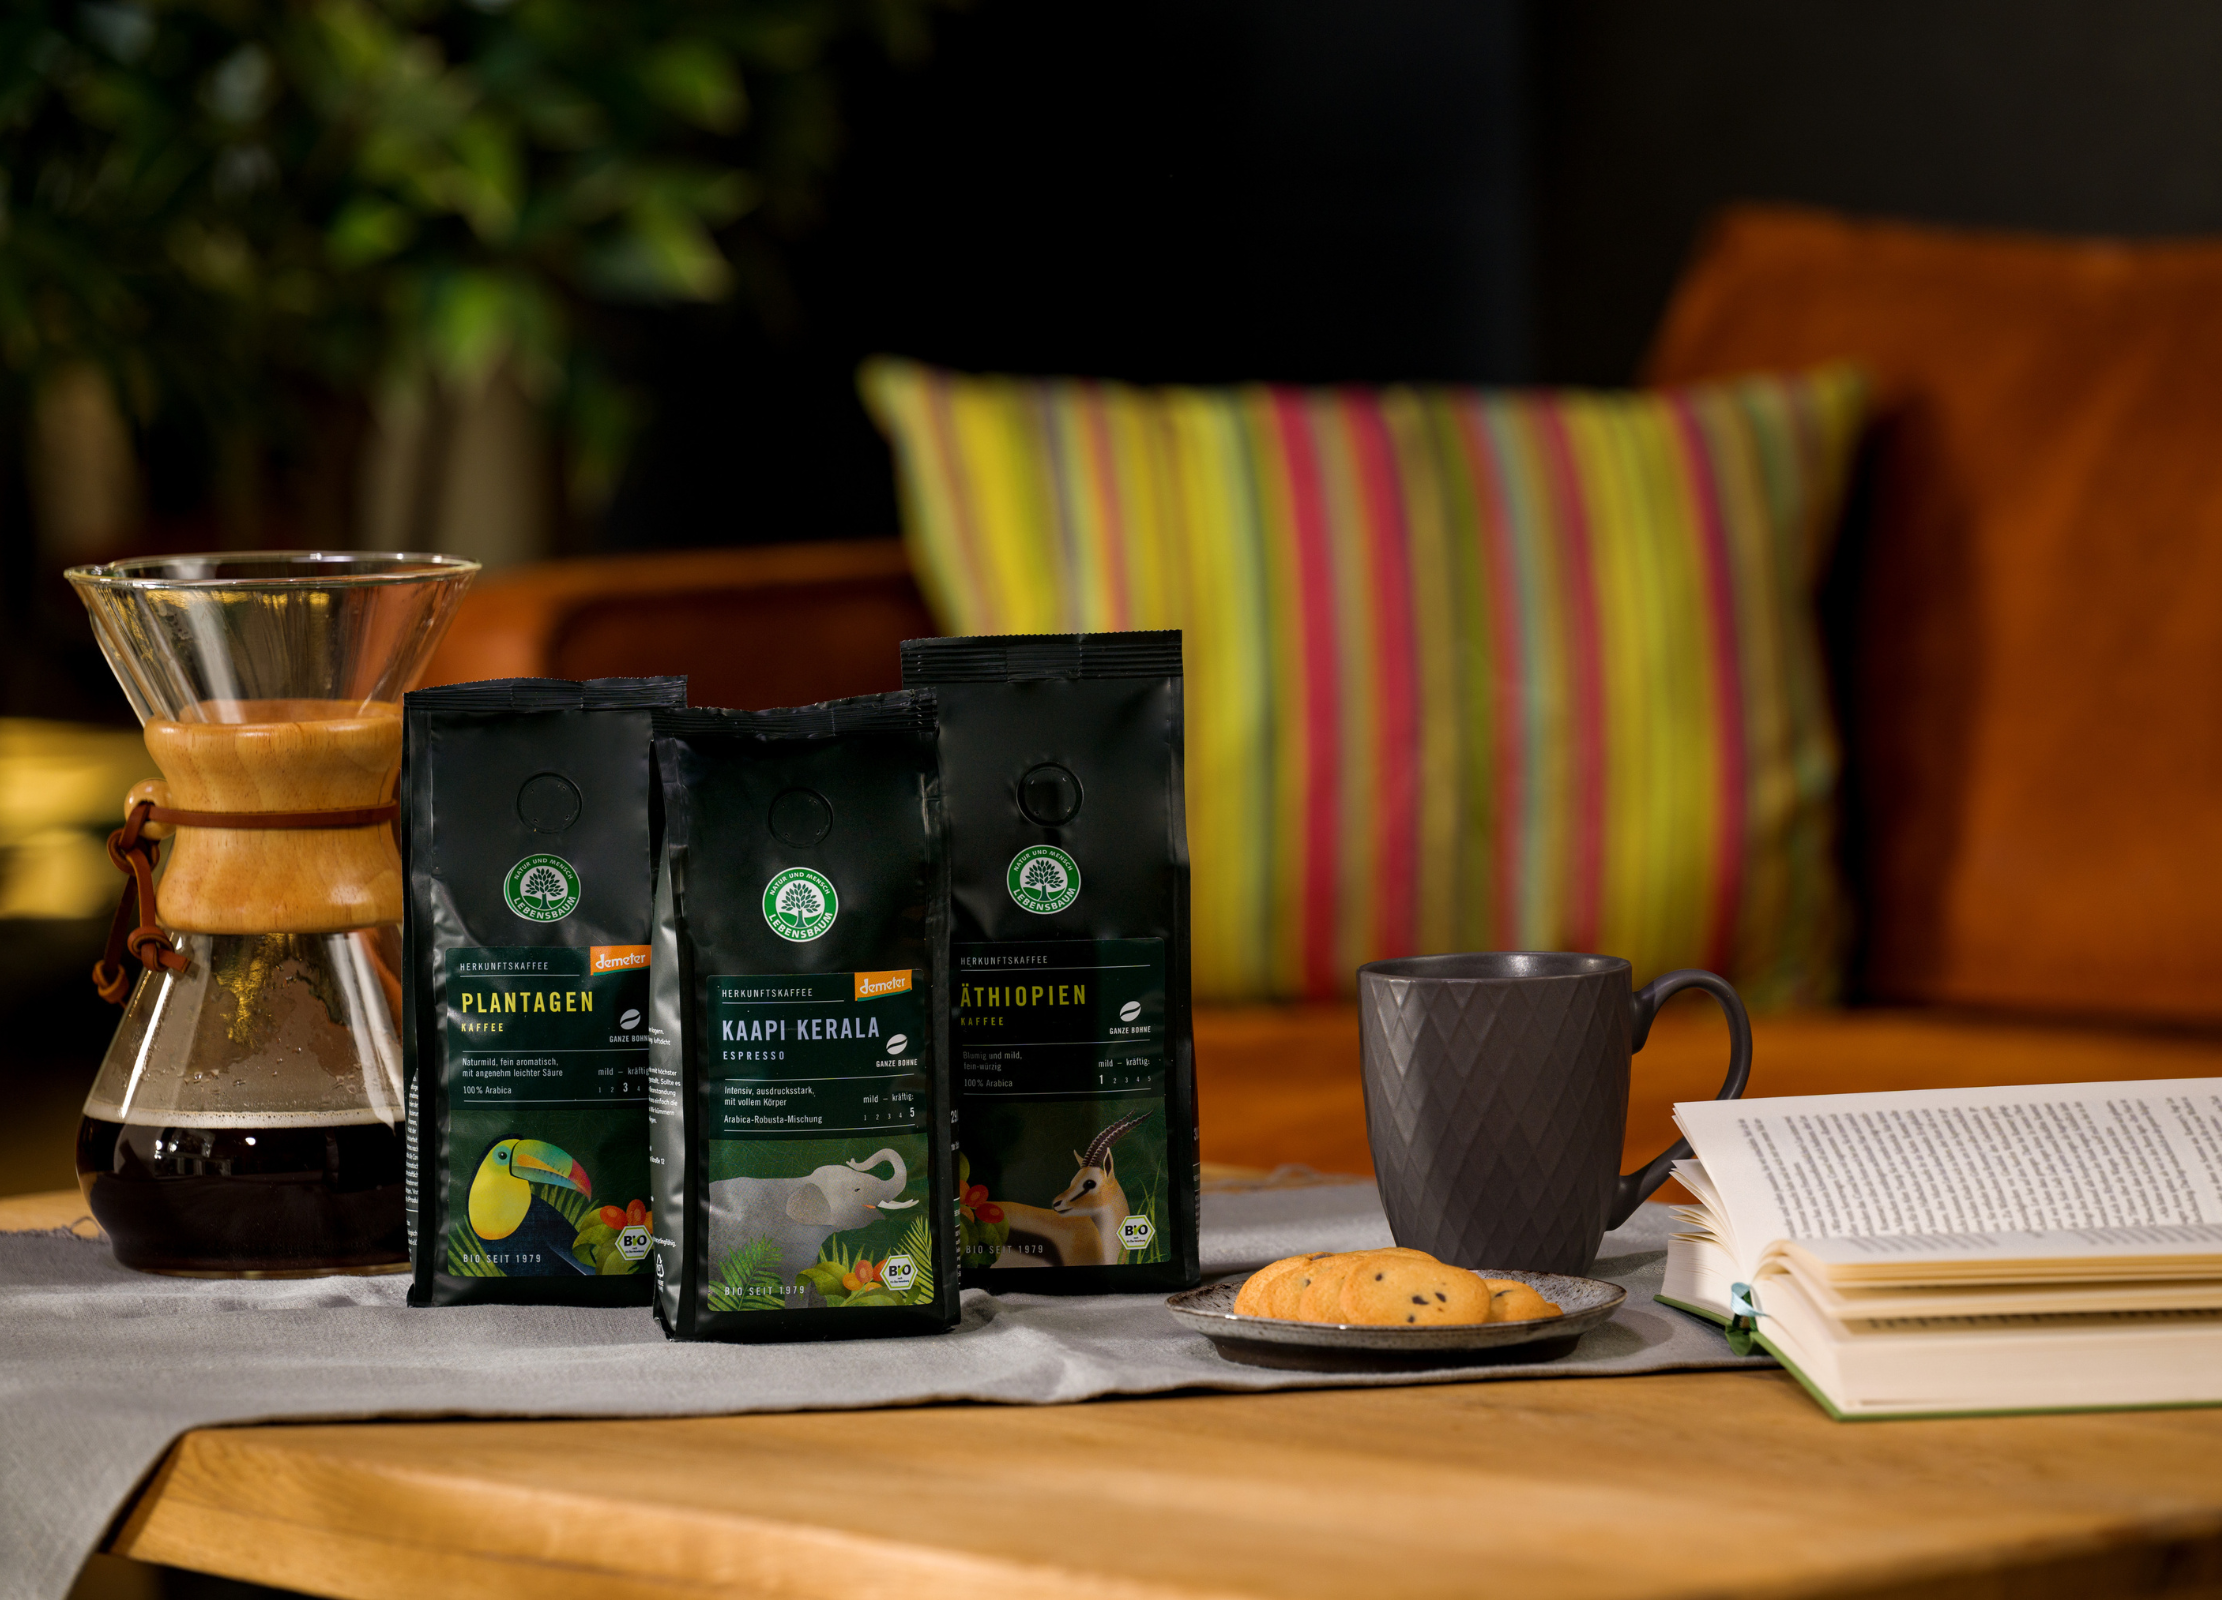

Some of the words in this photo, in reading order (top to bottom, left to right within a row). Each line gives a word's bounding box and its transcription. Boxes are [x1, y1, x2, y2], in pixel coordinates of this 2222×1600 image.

[1014, 853, 1031, 872] NATUR
[1049, 851, 1073, 871] MENSCH
[514, 862, 531, 880] NATUR
[550, 860, 574, 880] MENSCH
[770, 876, 787, 896] NATUR
[806, 874, 830, 895] MENSCH
[1013, 888, 1076, 911] LEBENSBAUM
[514, 896, 576, 919] LEBENSBAUM
[769, 912, 833, 938] LEBENSBAUM
[596, 954, 646, 969] demeter
[960, 956, 1048, 966] HERKUNFTSKAFFEE
[460, 962, 548, 971] HERKUNFTSKAFFEE
[860, 977, 905, 994] demeter
[722, 989, 813, 998] HERKUNFTSKAFFEE
[961, 983, 1086, 1007] ÄTHIOPIEN
[462, 992, 593, 1013] PLANTAGEN
[961, 1017, 1004, 1026] KAFFEE
[461, 1023, 504, 1032] KAFFEE
[723, 1020, 785, 1041] KAAPI
[797, 1017, 880, 1040] KERALA
[1110, 1027, 1129, 1035] GANZE
[1132, 1026, 1151, 1034] BOHNE
[723, 1051, 785, 1061] ESPRESSO
[989, 1051, 1002, 1060] und
[1004, 1051, 1022, 1060] mild,
[462, 1058, 498, 1067] Naturmild,
[500, 1058, 514, 1066] fein
[516, 1058, 558, 1067] aromatisch,
[876, 1060, 896, 1068] GANZE
[898, 1059, 918, 1067] BOHNE
[964, 1062, 1002, 1071] fein-würzig
[1126, 1058, 1150, 1067] kräftig:
[462, 1069, 474, 1077] mit
[476, 1069, 511, 1079] angenehm
[514, 1069, 540, 1077] leichter
[542, 1069, 563, 1077] Säure
[598, 1068, 614, 1076] mild
[986, 1079, 1013, 1087] Arabica
[1100, 1075, 1104, 1084] 1
[485, 1086, 512, 1094] Arabica
[623, 1082, 628, 1092] 3
[725, 1087, 754, 1095] Intensiv,
[757, 1087, 815, 1096] ausdrucksstark,
[725, 1098, 736, 1106] mit
[738, 1098, 761, 1106] vollem
[763, 1098, 787, 1108] Körper
[863, 1096, 879, 1104] mild
[892, 1094, 914, 1102] kräftig:
[910, 1107, 915, 1118] 5
[724, 1115, 823, 1124] Arabica-Robusta-Mischung
[966, 1246, 983, 1254] BIO
[989, 1245, 1012, 1254] SEIT
[1019, 1245, 1043, 1254] 1979
[464, 1255, 480, 1263] BIO
[486, 1255, 510, 1264] SEIT
[516, 1254, 541, 1263] 1979
[725, 1287, 743, 1296] BIO
[750, 1287, 772, 1296] SEIT
[780, 1286, 805, 1294] 1979
